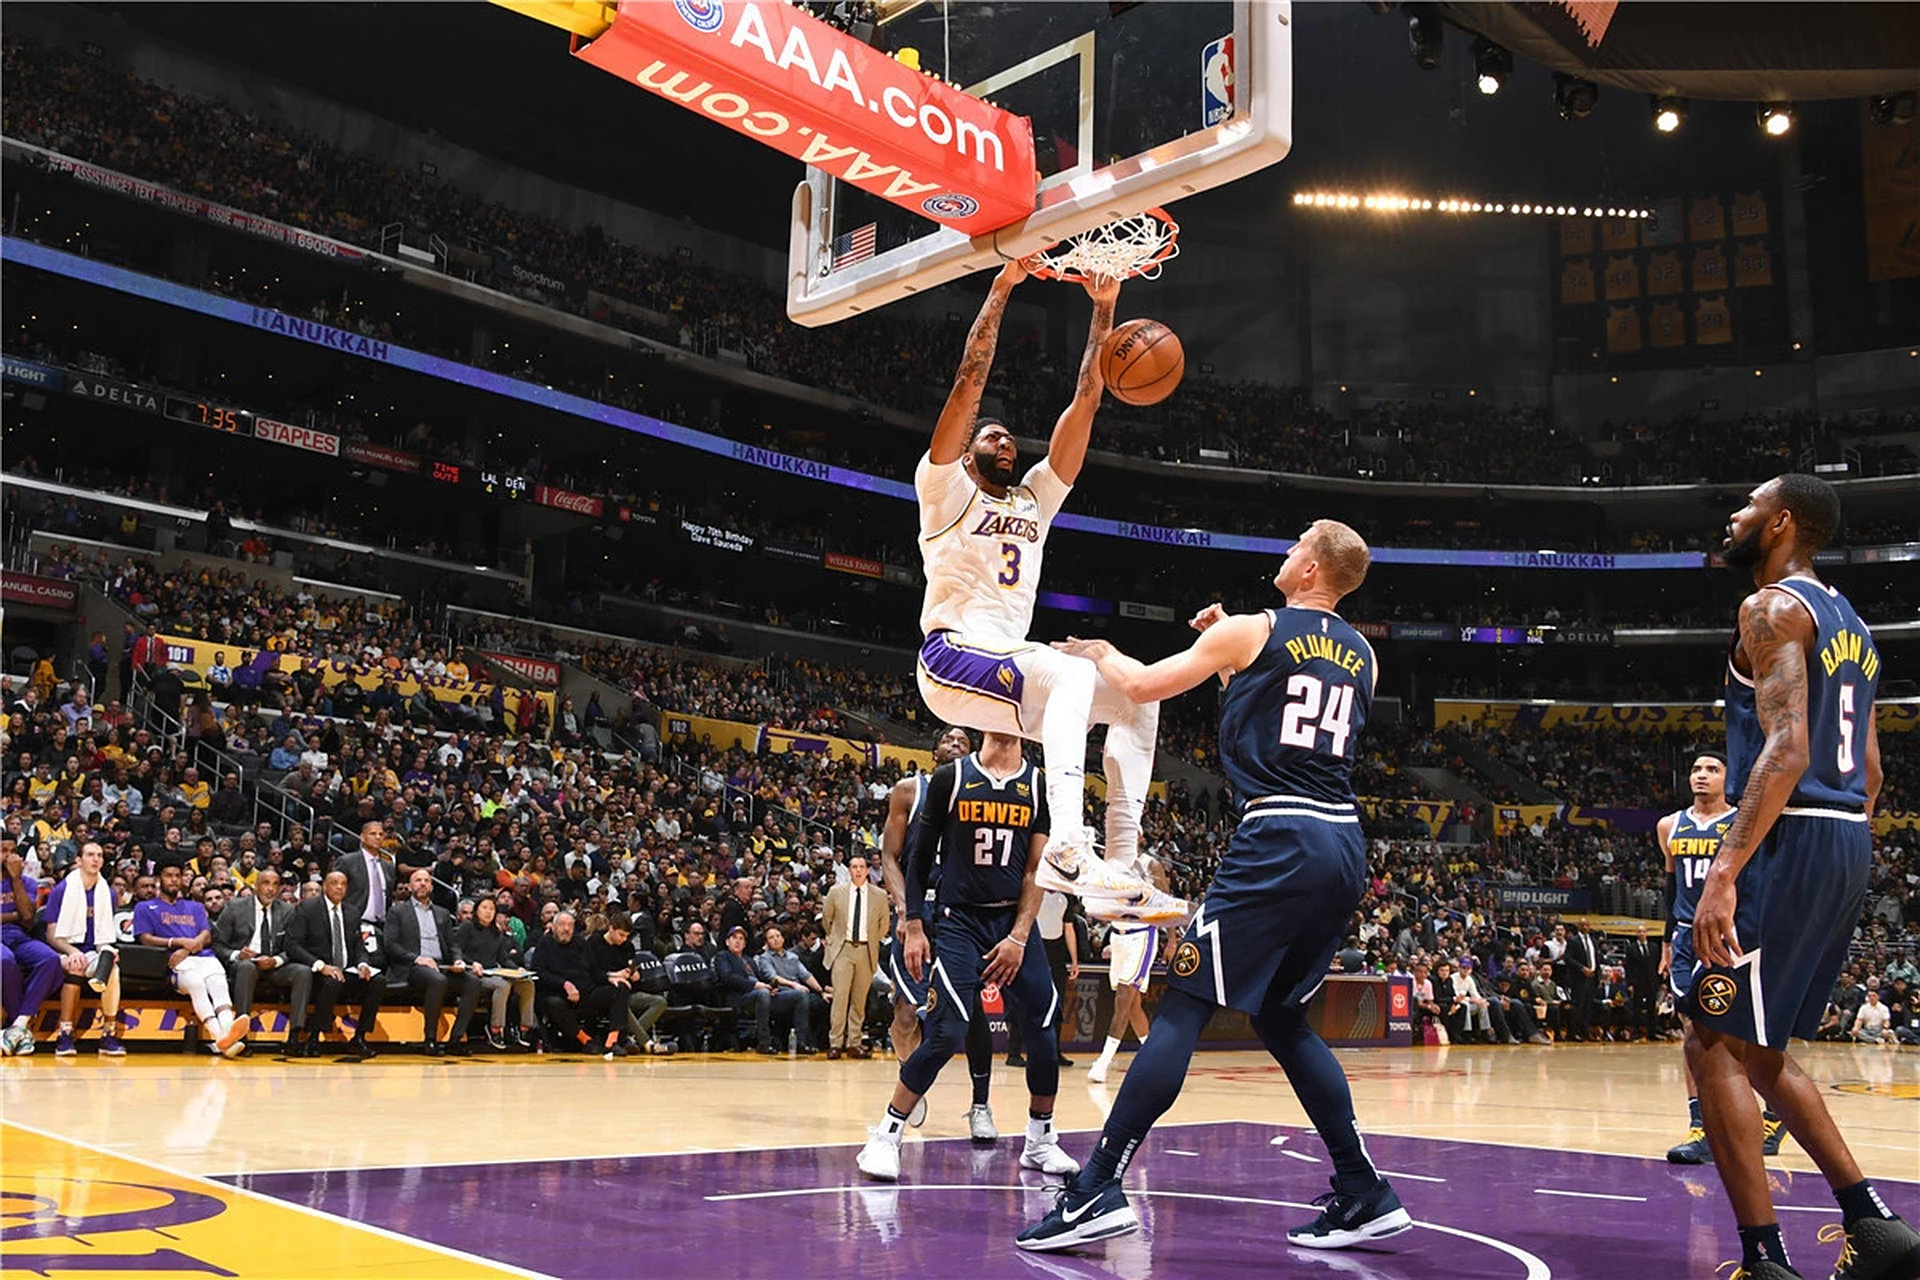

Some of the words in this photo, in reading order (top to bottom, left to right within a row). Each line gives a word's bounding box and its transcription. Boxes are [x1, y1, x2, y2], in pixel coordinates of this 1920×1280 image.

[731, 2, 1005, 172] AAA.com
[636, 60, 942, 198] AAA.com
[73, 164, 133, 194] ASSISTANCE?
[134, 182, 156, 202] TEXT
[207, 206, 232, 226] ISSUE
[247, 218, 285, 241] LOCATION
[297, 234, 338, 257] 69050
[512, 264, 565, 292] Spectrum
[252, 307, 388, 360] HANUKKAH
[7, 366, 47, 383] LIGHT
[94, 384, 157, 410] DELTA
[256, 419, 337, 453] STAPLES
[433, 461, 460, 474] TIME
[732, 442, 830, 479] HANUKKAH
[432, 471, 459, 484] OUTS
[505, 477, 526, 491] DEN
[681, 520, 705, 535] Happy
[725, 530, 755, 546] Birthday
[1118, 523, 1211, 546] HANUKKAH
[828, 555, 854, 569] WELLS
[855, 561, 880, 573] FARGO
[999, 542, 1022, 589] 3
[1514, 554, 1615, 568] HANUKKAH
[37, 586, 74, 600] CASINO
[1351, 623, 1387, 636] HIBA
[1568, 632, 1609, 643] DELTA
[166, 646, 188, 662] 101
[1284, 633, 1365, 678] PLUMLEE
[491, 654, 558, 683] HIBA
[1279, 673, 1355, 758] 24
[1837, 682, 1855, 775] 5
[958, 800, 1031, 828] DENVER
[974, 827, 1014, 867] 27
[1671, 838, 1720, 857] DENVE
[1683, 857, 1711, 888] 14
[1503, 890, 1529, 902] BUD
[1531, 891, 1570, 905] LIGHT
[640, 960, 662, 970] ELTA
[989, 1021, 1008, 1032] OTA
[1389, 1021, 1412, 1032] TOYOTA
